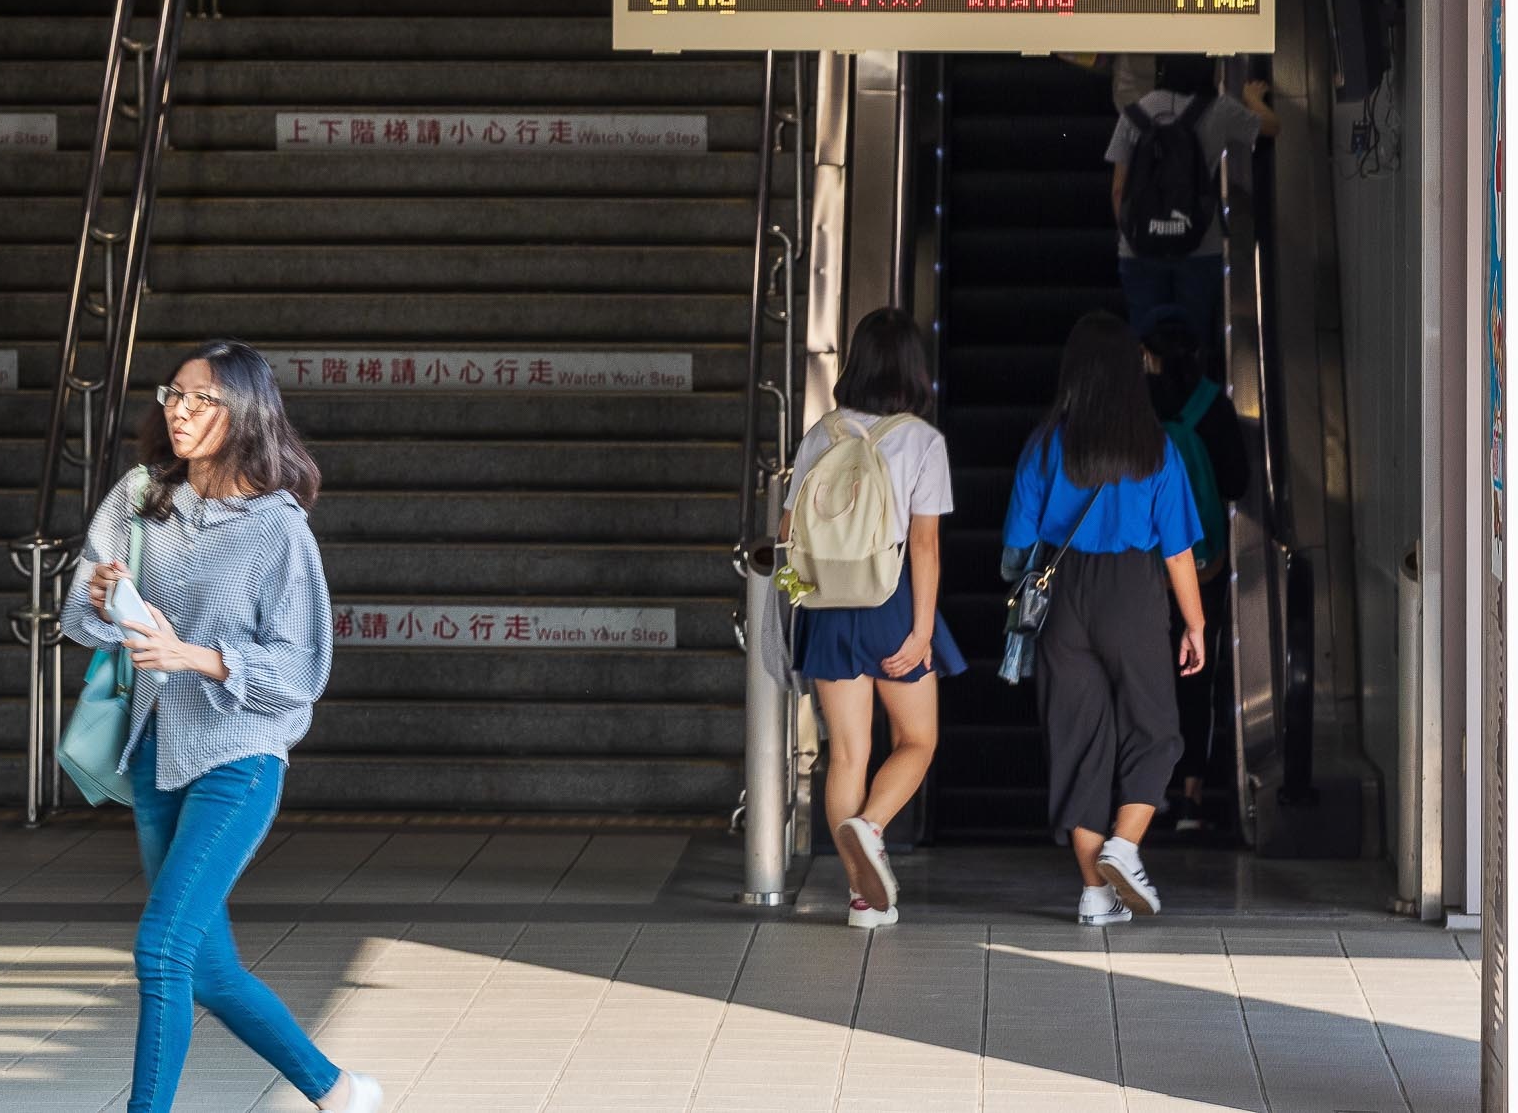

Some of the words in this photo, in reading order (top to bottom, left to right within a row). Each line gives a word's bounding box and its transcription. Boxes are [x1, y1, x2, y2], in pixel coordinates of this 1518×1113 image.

[14, 132, 50, 147] Step
[286, 117, 574, 146] 上下階梯請小心行走
[576, 131, 624, 145] Watch
[627, 131, 662, 145] Your
[664, 131, 701, 147] Step
[270, 357, 554, 386] 下階梯請小心行走
[557, 372, 607, 386] Watch
[610, 372, 646, 386] Your
[649, 372, 686, 388] Step
[535, 627, 585, 642] Watch
[591, 627, 627, 641] Your
[631, 627, 669, 643] Step
